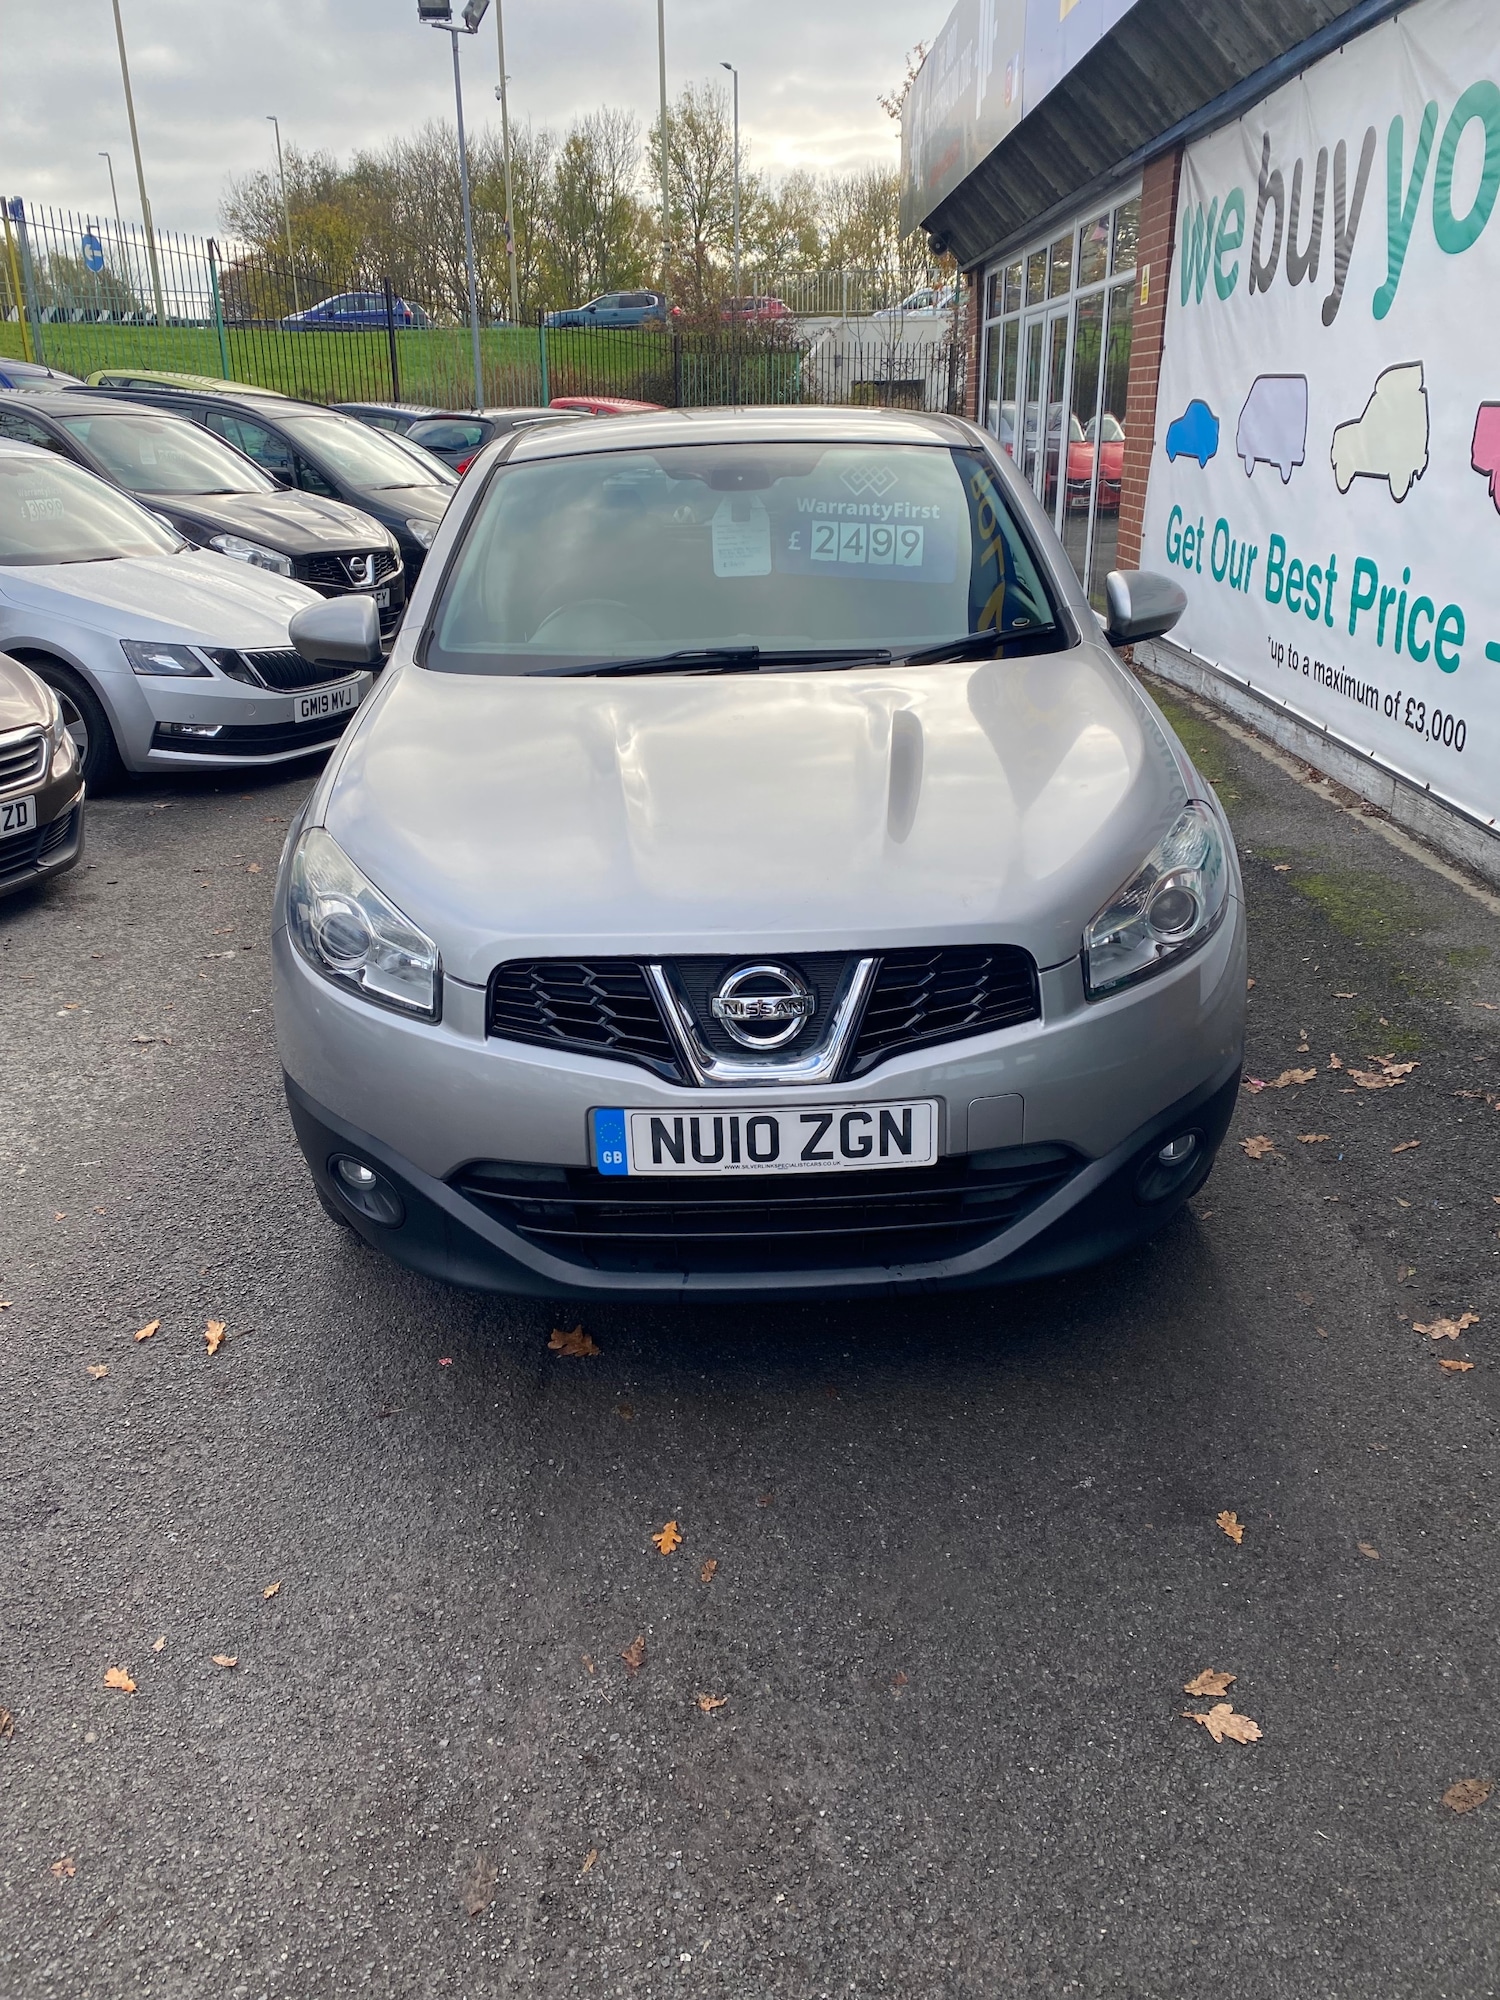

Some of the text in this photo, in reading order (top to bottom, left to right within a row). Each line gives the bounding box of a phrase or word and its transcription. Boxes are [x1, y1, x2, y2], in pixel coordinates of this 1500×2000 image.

[797, 497, 940, 521] WarrantyFirst
[814, 525, 921, 559] 2499
[1166, 504, 1466, 673] Get Our Best Price
[301, 688, 351, 717] GM19 MVJ
[1287, 644, 1299, 671] to
[1303, 657, 1310, 676] a
[1314, 659, 1379, 711] maximum
[1384, 691, 1401, 717] of
[1405, 697, 1466, 753] £3,000
[723, 1002, 805, 1016] NISSAN
[651, 1109, 912, 1164] NU10 ZGN
[603, 1151, 622, 1164] GB
[724, 1161, 841, 1170] WWW.SILVERLINKSPECIALISTCARS.CO.UK
